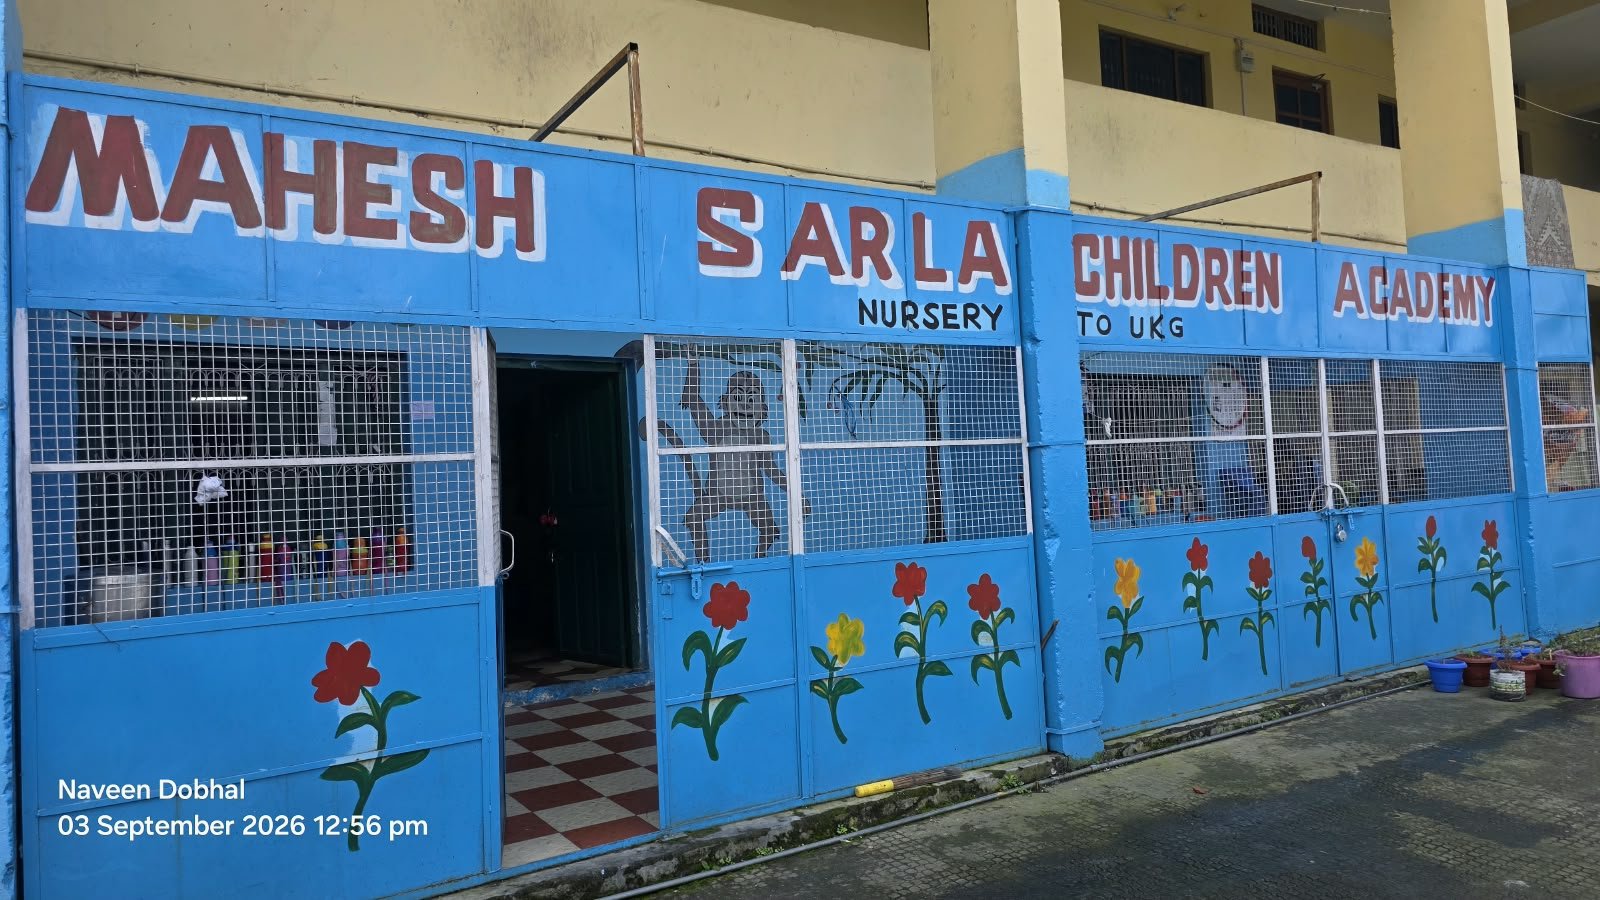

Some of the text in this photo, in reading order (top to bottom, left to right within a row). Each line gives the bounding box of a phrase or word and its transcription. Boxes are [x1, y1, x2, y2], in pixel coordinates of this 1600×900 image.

[25, 105, 1496, 328] MAHESH SARLA CHILDREN ACADEMY
[858, 298, 1184, 341] NURSERY TO UKG
